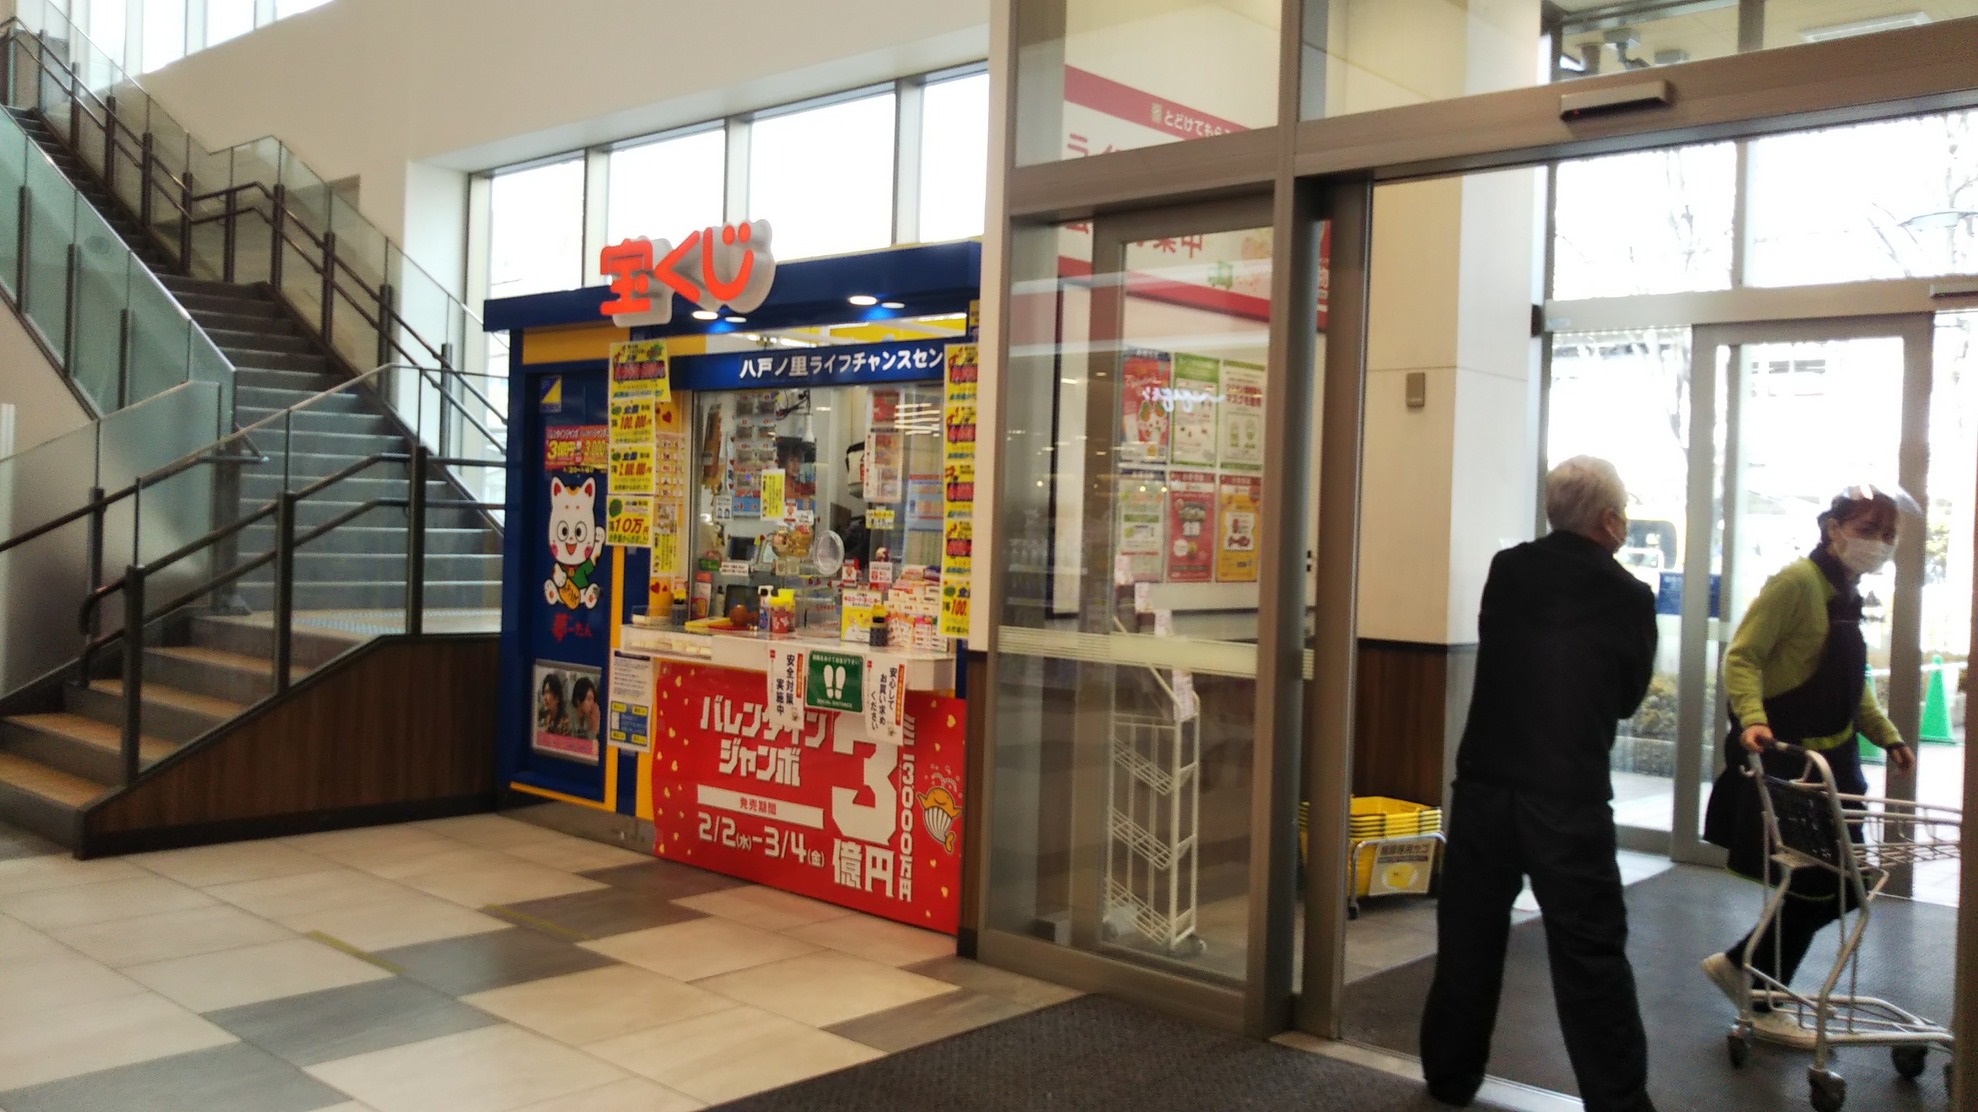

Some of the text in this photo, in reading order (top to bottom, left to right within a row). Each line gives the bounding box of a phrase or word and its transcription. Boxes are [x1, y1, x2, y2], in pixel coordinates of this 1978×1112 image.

[600, 222, 754, 316] 宝くじ
[776, 678, 785, 716] 実施中
[870, 690, 879, 731] ください
[879, 673, 887, 726] お買い求め
[888, 667, 897, 711] 安心して
[719, 737, 802, 787] ジャンボ
[738, 797, 778, 815] 発売期間
